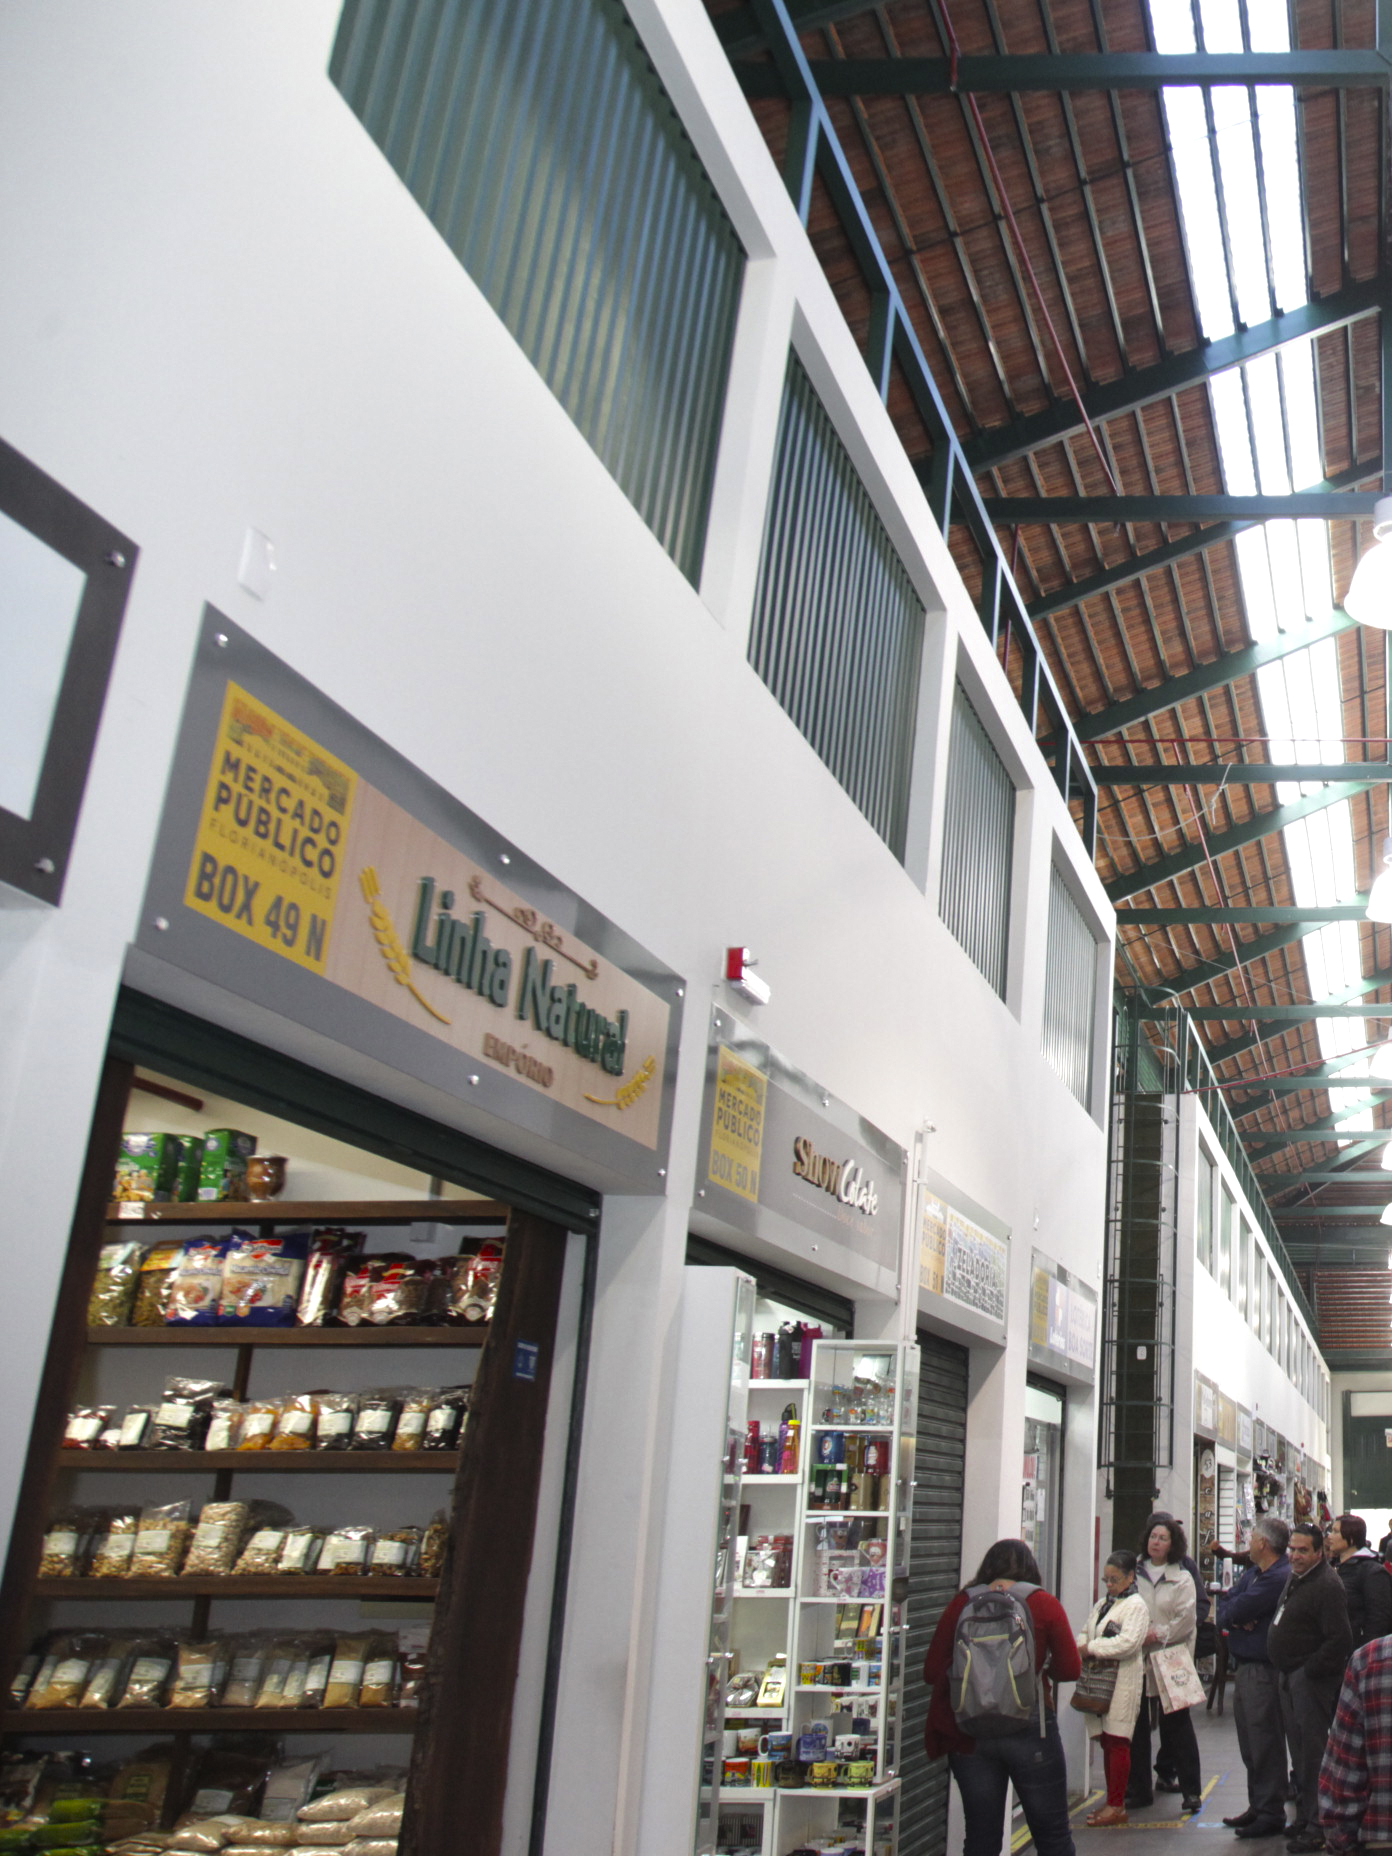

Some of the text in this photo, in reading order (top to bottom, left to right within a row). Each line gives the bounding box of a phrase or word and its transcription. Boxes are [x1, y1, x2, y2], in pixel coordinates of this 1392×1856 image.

[212, 780, 336, 879] PÚBLICO
[220, 749, 341, 847] MERCADO
[194, 850, 327, 963] BOX 49 N
[412, 876, 630, 1077] Linha Natural
[483, 1031, 554, 1089] EMPÓRIO
[718, 1087, 761, 1125] MERCADO
[711, 1148, 733, 1184] BOX
[735, 1160, 748, 1191] 50
